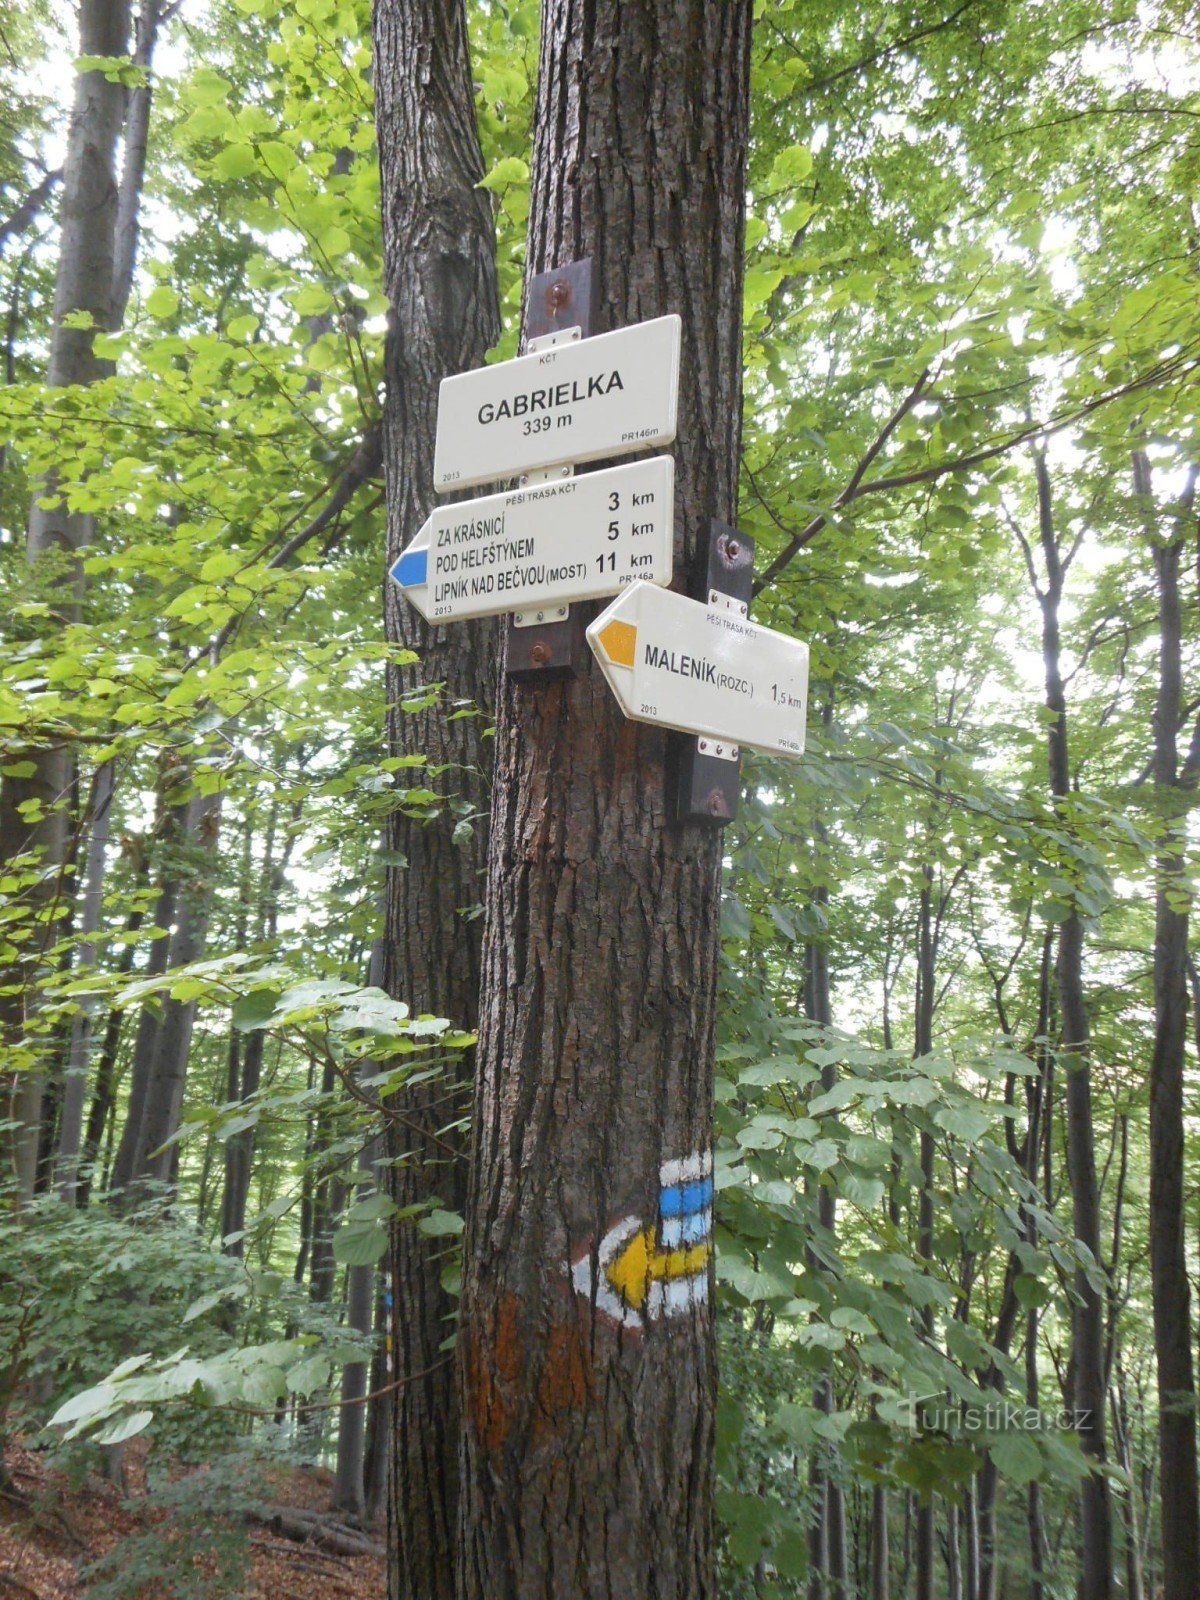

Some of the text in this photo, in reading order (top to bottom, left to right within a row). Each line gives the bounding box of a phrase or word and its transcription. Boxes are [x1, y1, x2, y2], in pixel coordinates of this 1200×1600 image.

[539, 352, 557, 365] KČT
[477, 370, 624, 425] GABRIELKA
[522, 413, 572, 436] 339 m
[621, 427, 659, 442] PR146m
[442, 470, 461, 482] 2013
[528, 487, 557, 502] TRASA
[558, 482, 577, 495] KČT
[608, 491, 655, 511] 3 km
[437, 511, 505, 547] ZA KRÁSNICÍ
[607, 520, 654, 541] 5 km
[436, 537, 534, 574] POD HELFŠTÝNEM
[595, 551, 653, 574] 11 km
[435, 576, 468, 603] LIPNÍK
[471, 574, 494, 596] NAD
[434, 605, 452, 616] 2013
[771, 683, 802, 709] 1,5 km
[640, 703, 658, 716] 2013
